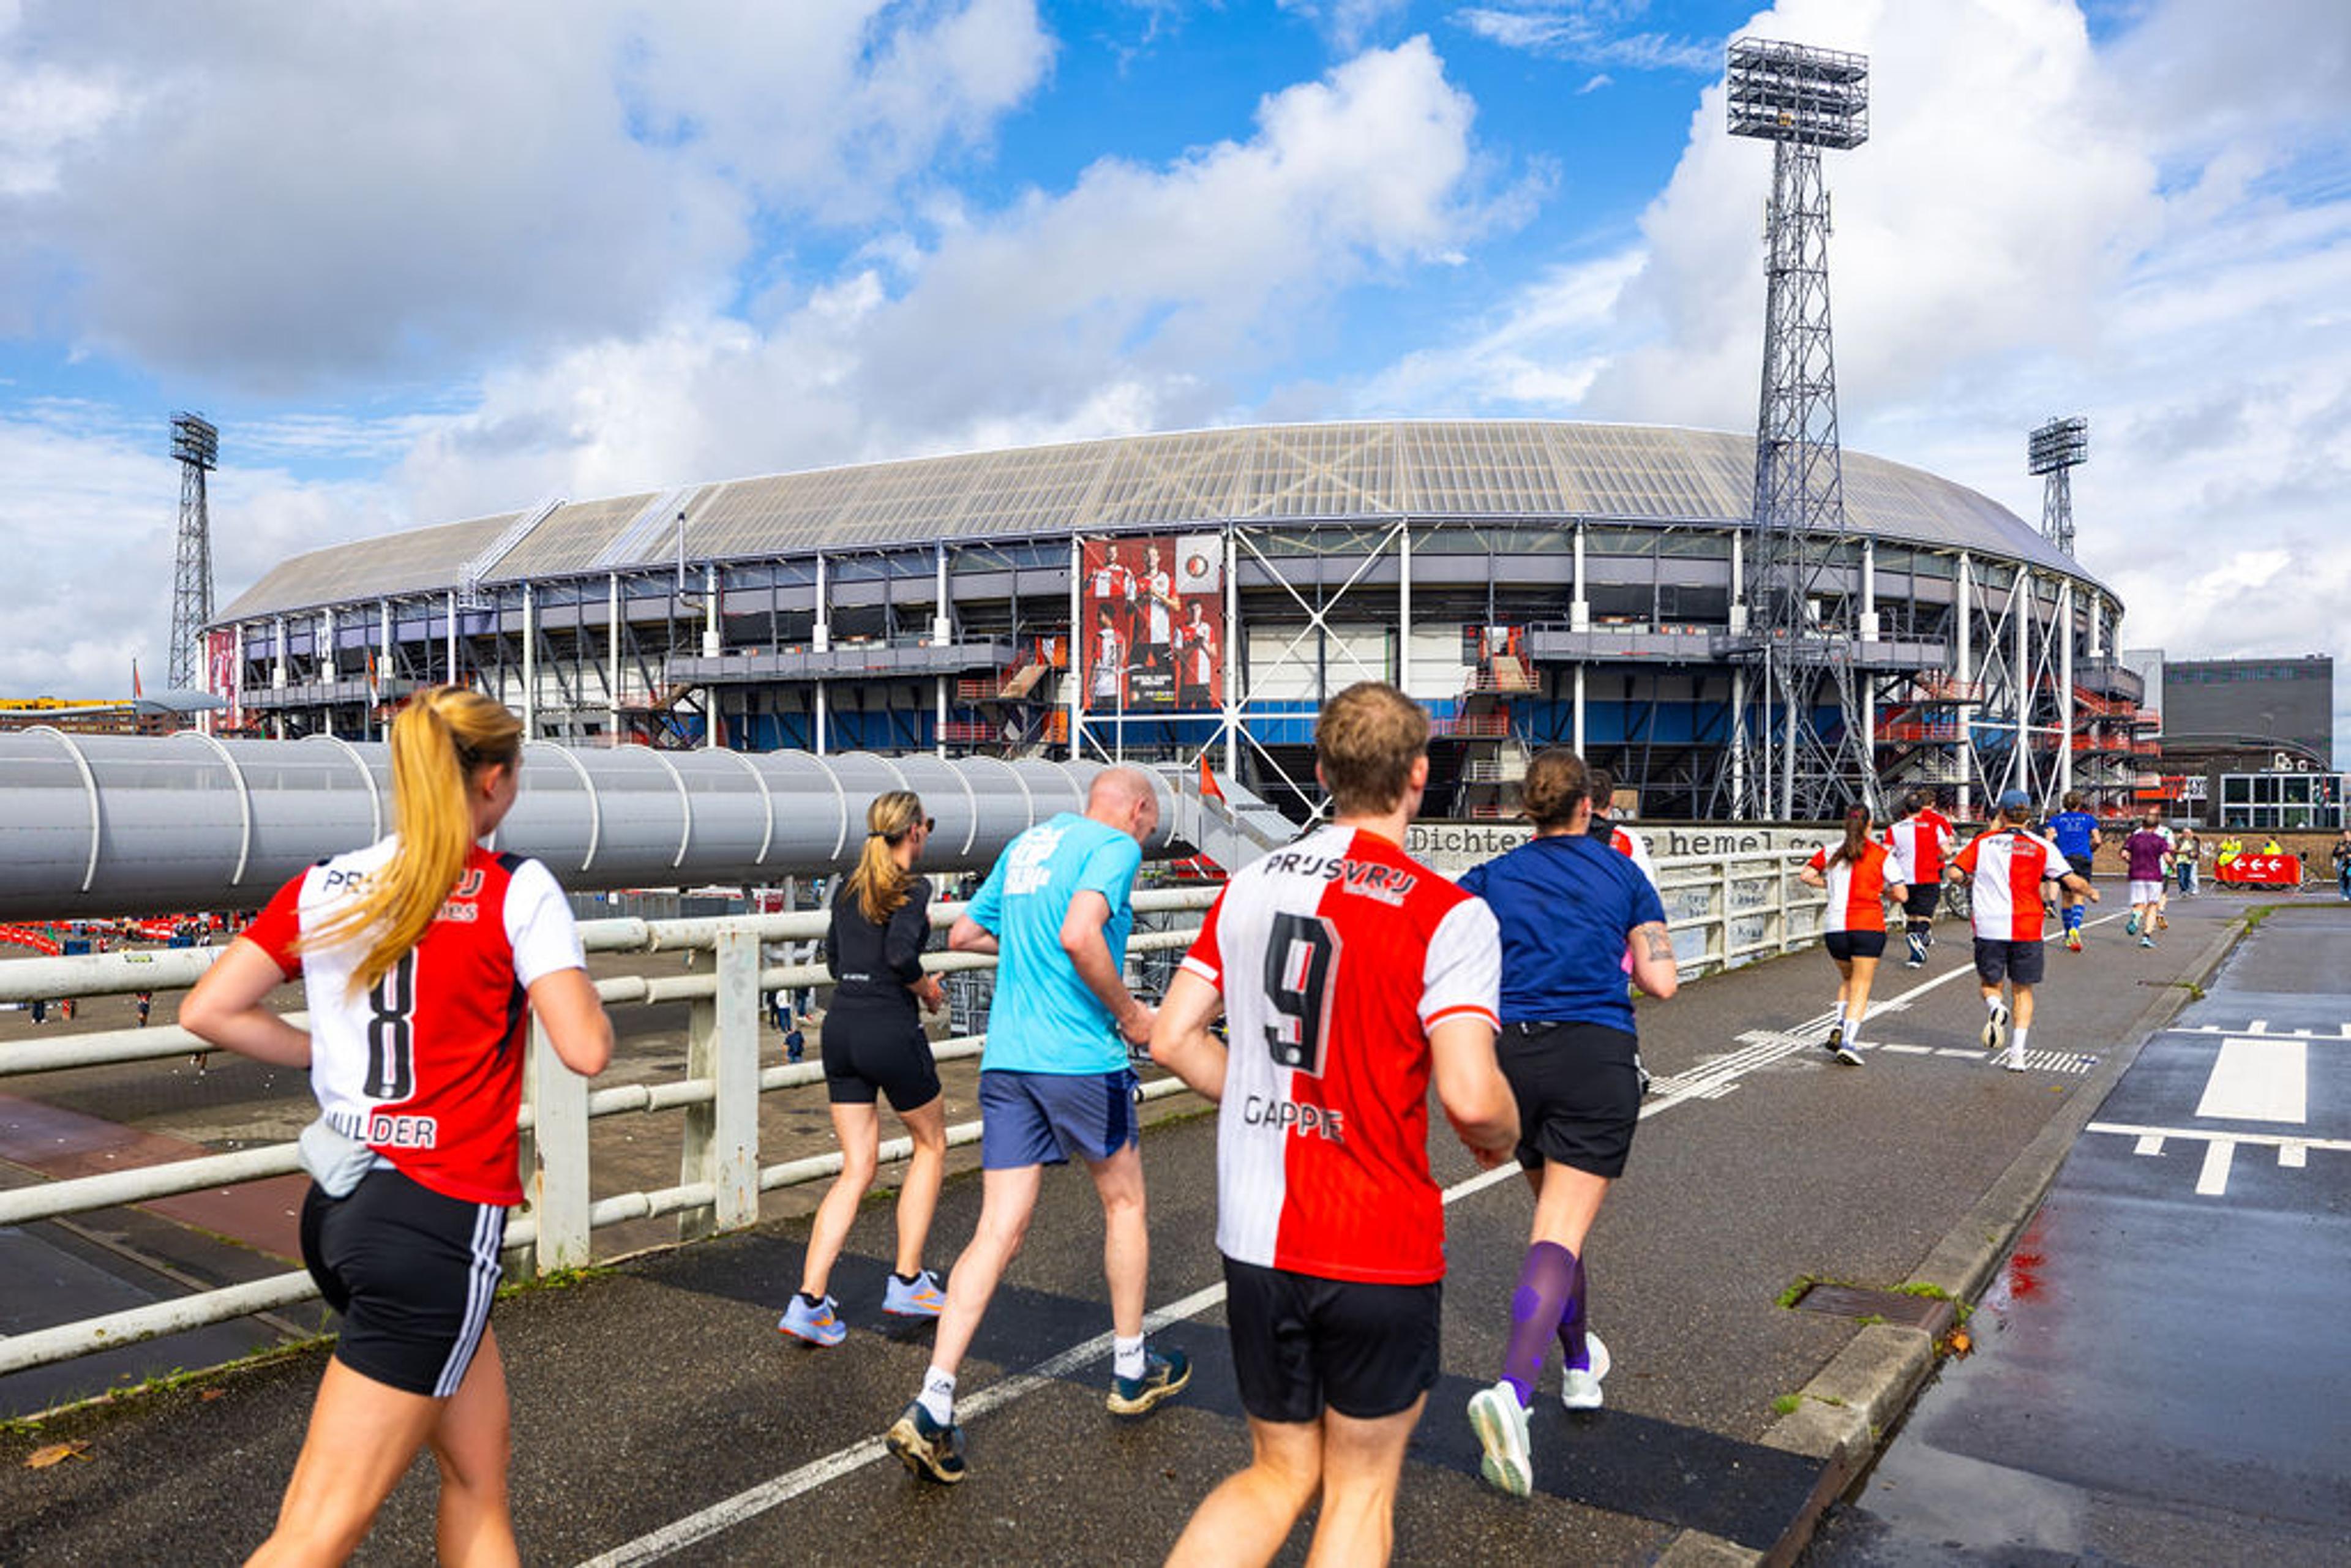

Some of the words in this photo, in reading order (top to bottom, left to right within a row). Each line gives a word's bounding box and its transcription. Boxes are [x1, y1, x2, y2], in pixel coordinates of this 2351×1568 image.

[1410, 827, 1532, 853] Dichter
[1669, 831, 1771, 855] hemel
[362, 944, 419, 1101] 8
[1264, 911, 1343, 1079] 9
